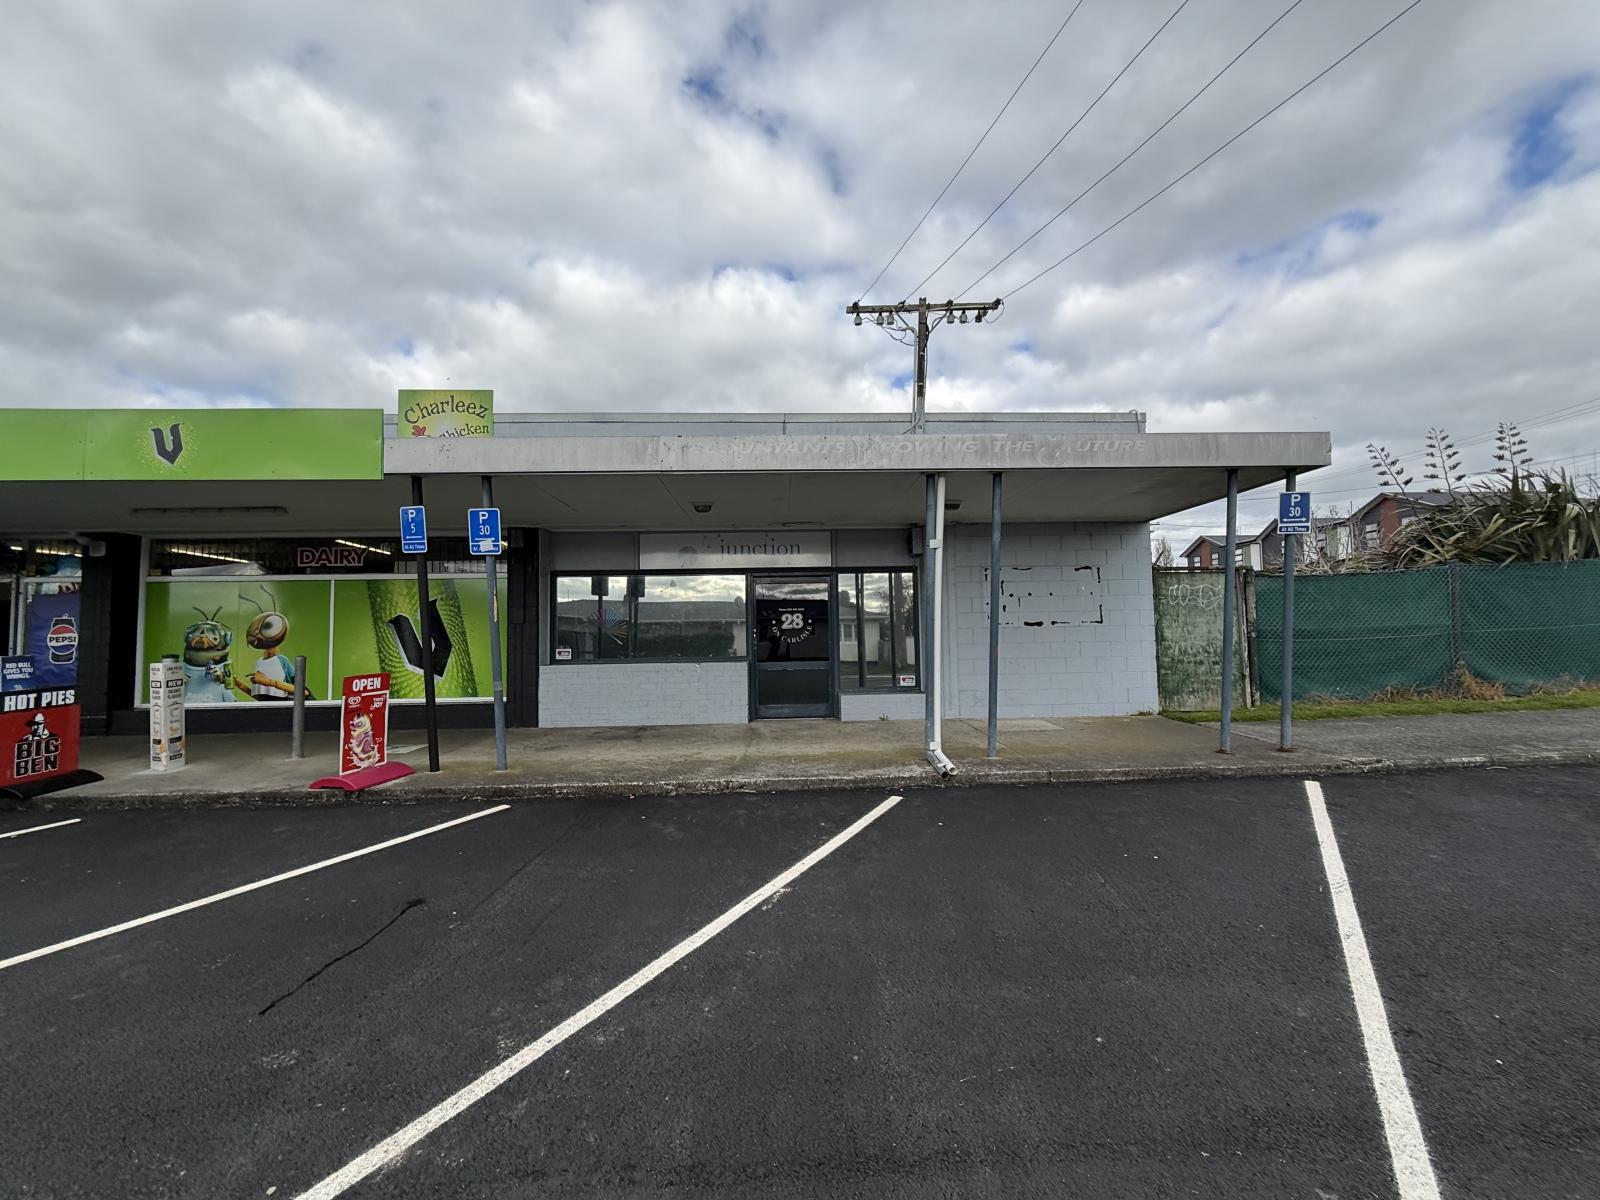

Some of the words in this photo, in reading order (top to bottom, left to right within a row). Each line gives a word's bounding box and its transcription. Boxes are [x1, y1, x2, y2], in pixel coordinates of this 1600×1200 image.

[404, 394, 490, 424] Charleez
[992, 440, 1035, 452] THE
[1076, 439, 1147, 452] UTURE
[1291, 494, 1301, 506] P
[408, 509, 416, 522] P
[479, 511, 489, 524] P
[1289, 507, 1301, 517] 30
[410, 523, 416, 533] 5
[479, 525, 490, 535] 30
[297, 546, 368, 567] DAIRY
[719, 539, 801, 560] junction
[781, 613, 804, 630] 28
[772, 626, 780, 637] ON
[781, 625, 813, 643] CARLISLE
[352, 677, 382, 692] OPEN
[3, 693, 38, 712] HOT
[41, 689, 76, 708] PIES
[15, 737, 61, 761] BIG
[14, 755, 58, 778] BEN
